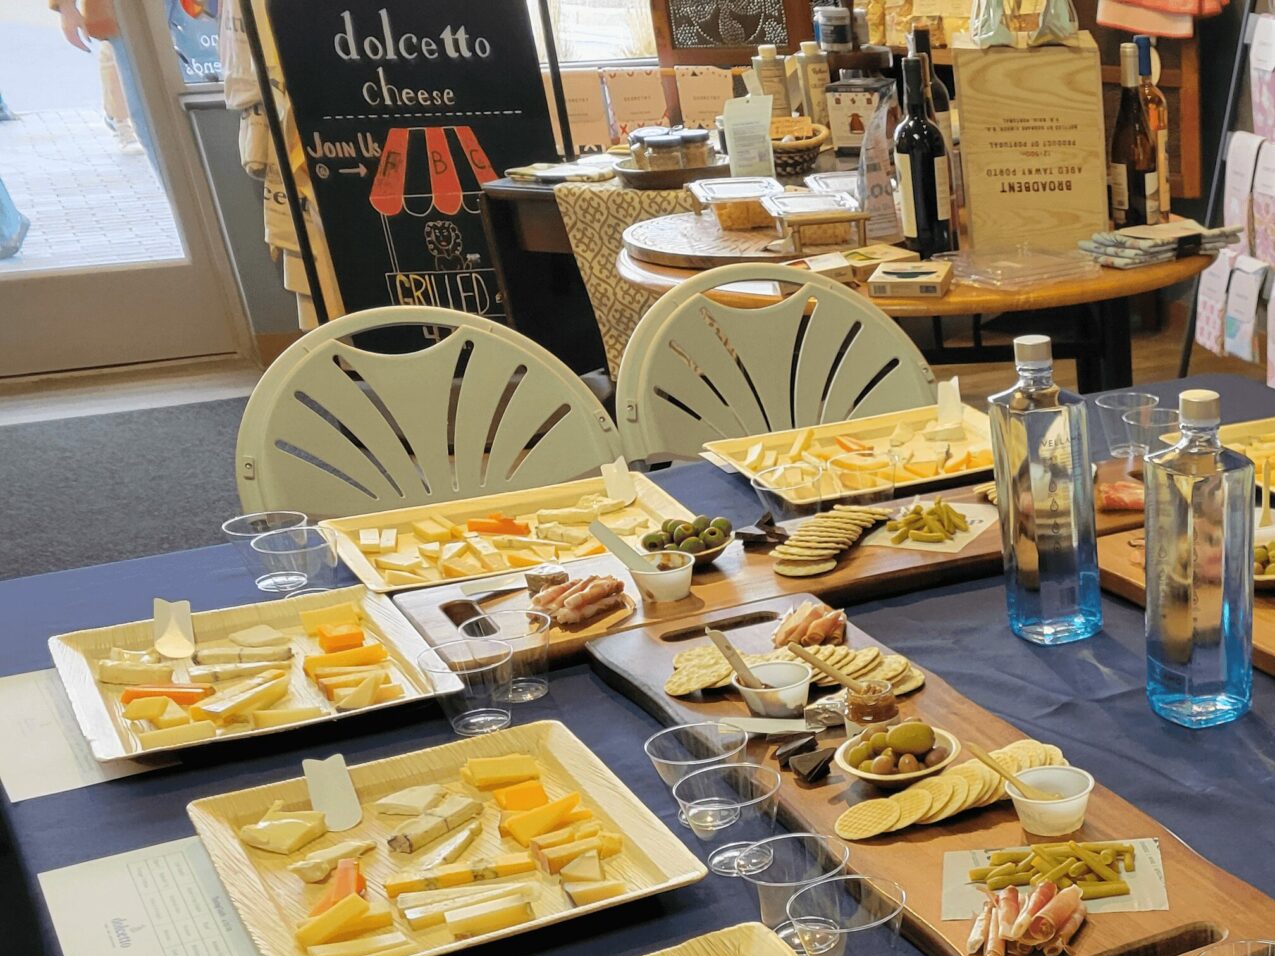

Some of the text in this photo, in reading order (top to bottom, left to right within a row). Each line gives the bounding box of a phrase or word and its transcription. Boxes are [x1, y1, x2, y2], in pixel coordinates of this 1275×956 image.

[334, 8, 491, 60] dolcetto
[362, 66, 455, 105] cheese
[989, 141, 1027, 149] PORTUGAL
[431, 151, 448, 175] B
[986, 168, 1017, 177] PORTO
[1022, 167, 1054, 175] TAWNY
[1000, 180, 1072, 193] BROADBENT
